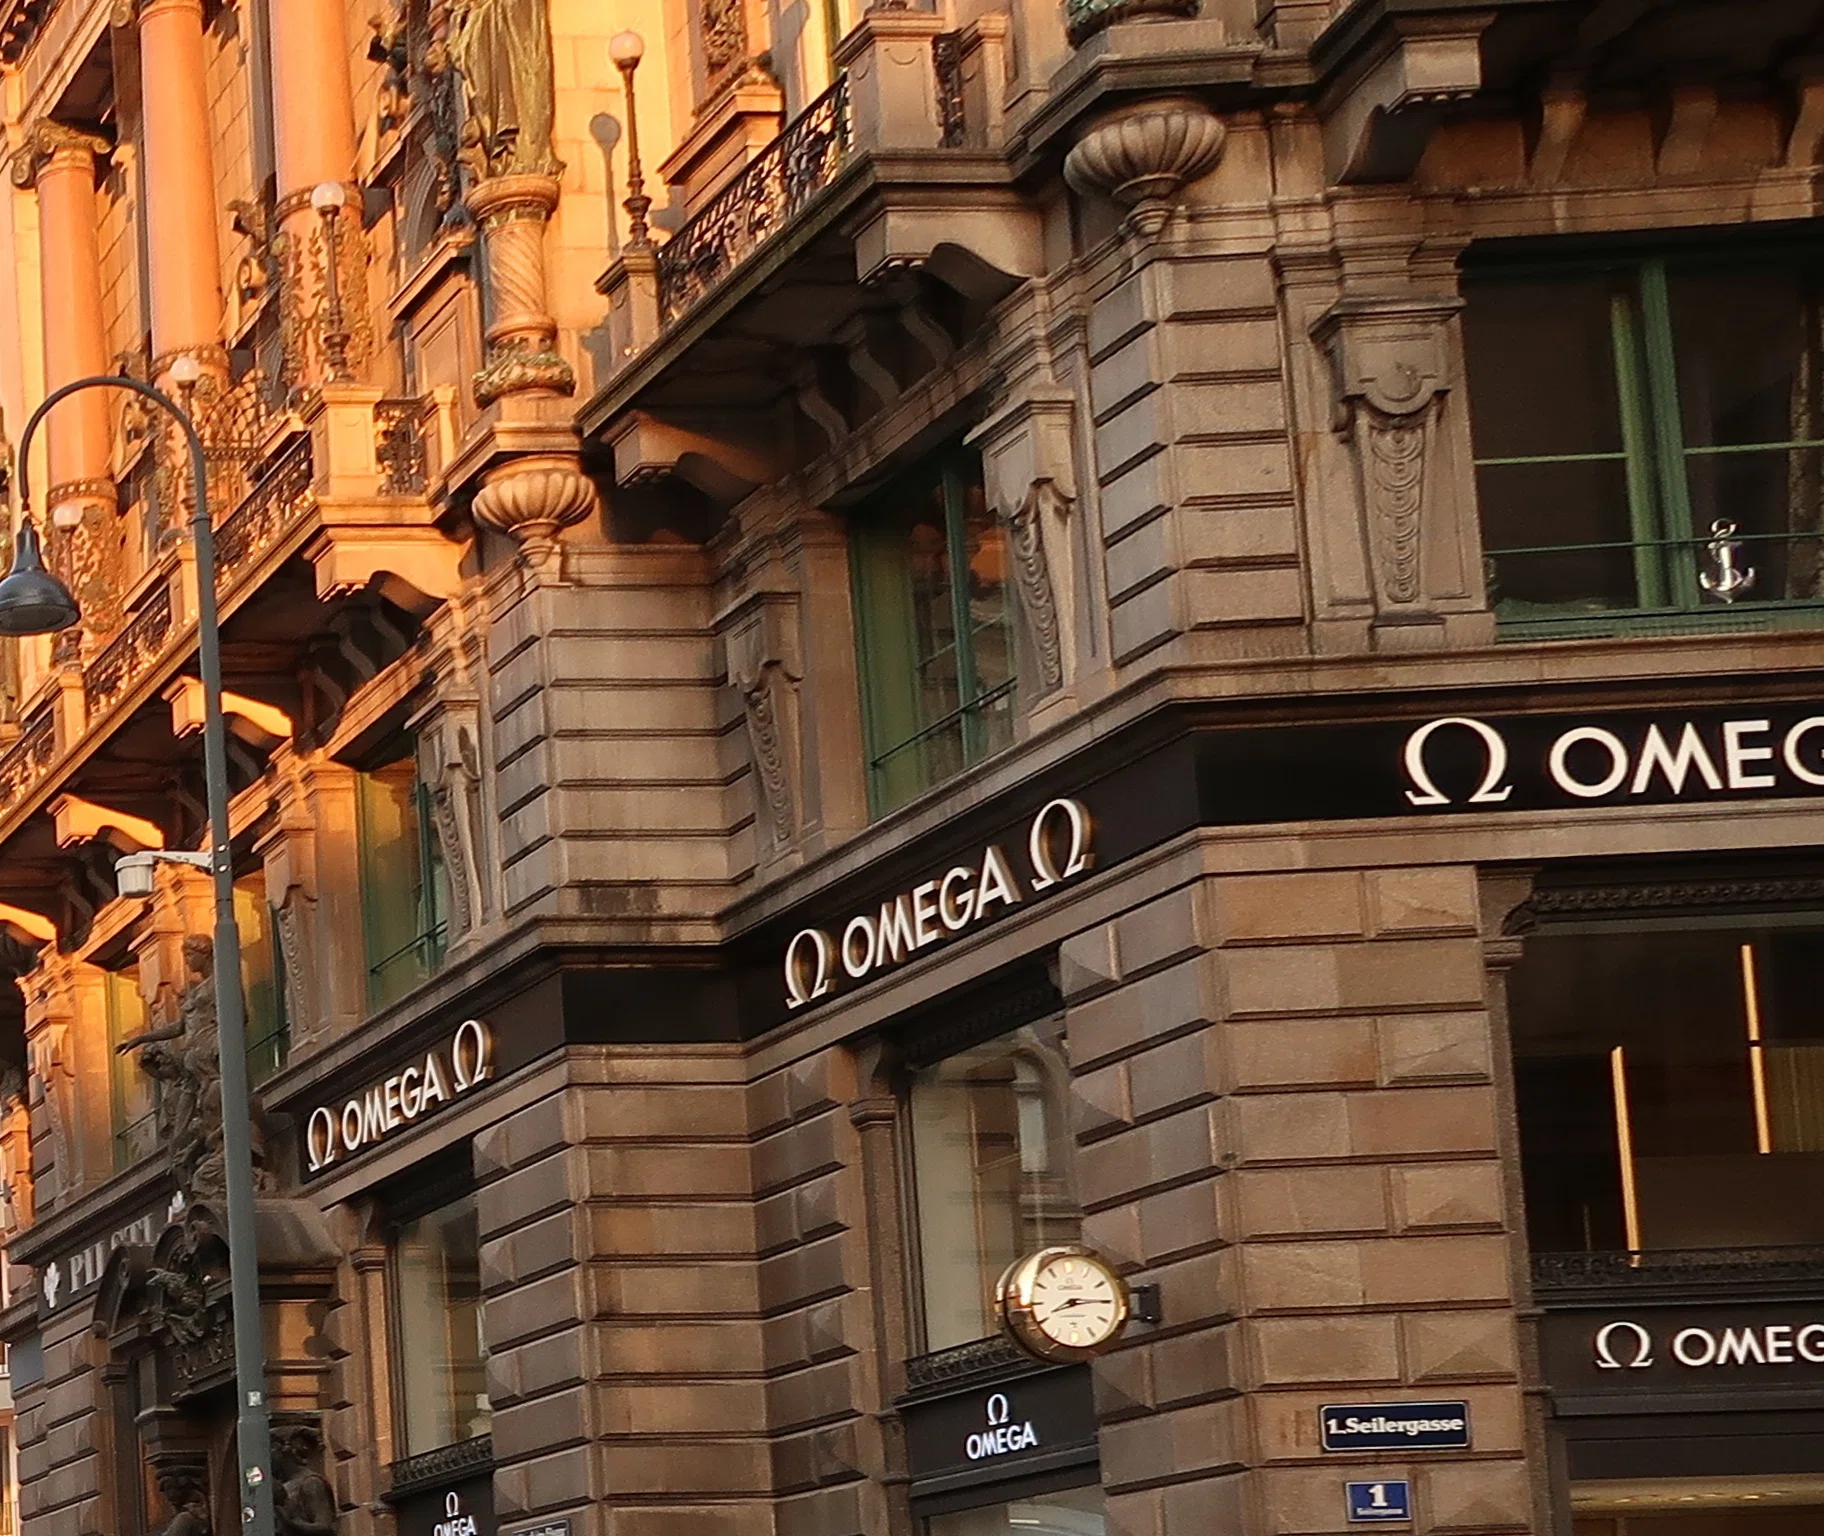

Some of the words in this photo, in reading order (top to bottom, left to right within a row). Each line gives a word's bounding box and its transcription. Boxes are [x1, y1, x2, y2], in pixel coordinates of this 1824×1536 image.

[840, 845, 1020, 980] OMEGA
[341, 1052, 448, 1153] OMEGA
[966, 1420, 1038, 1460] OMEGA
[1367, 1484, 1388, 1507] 1
